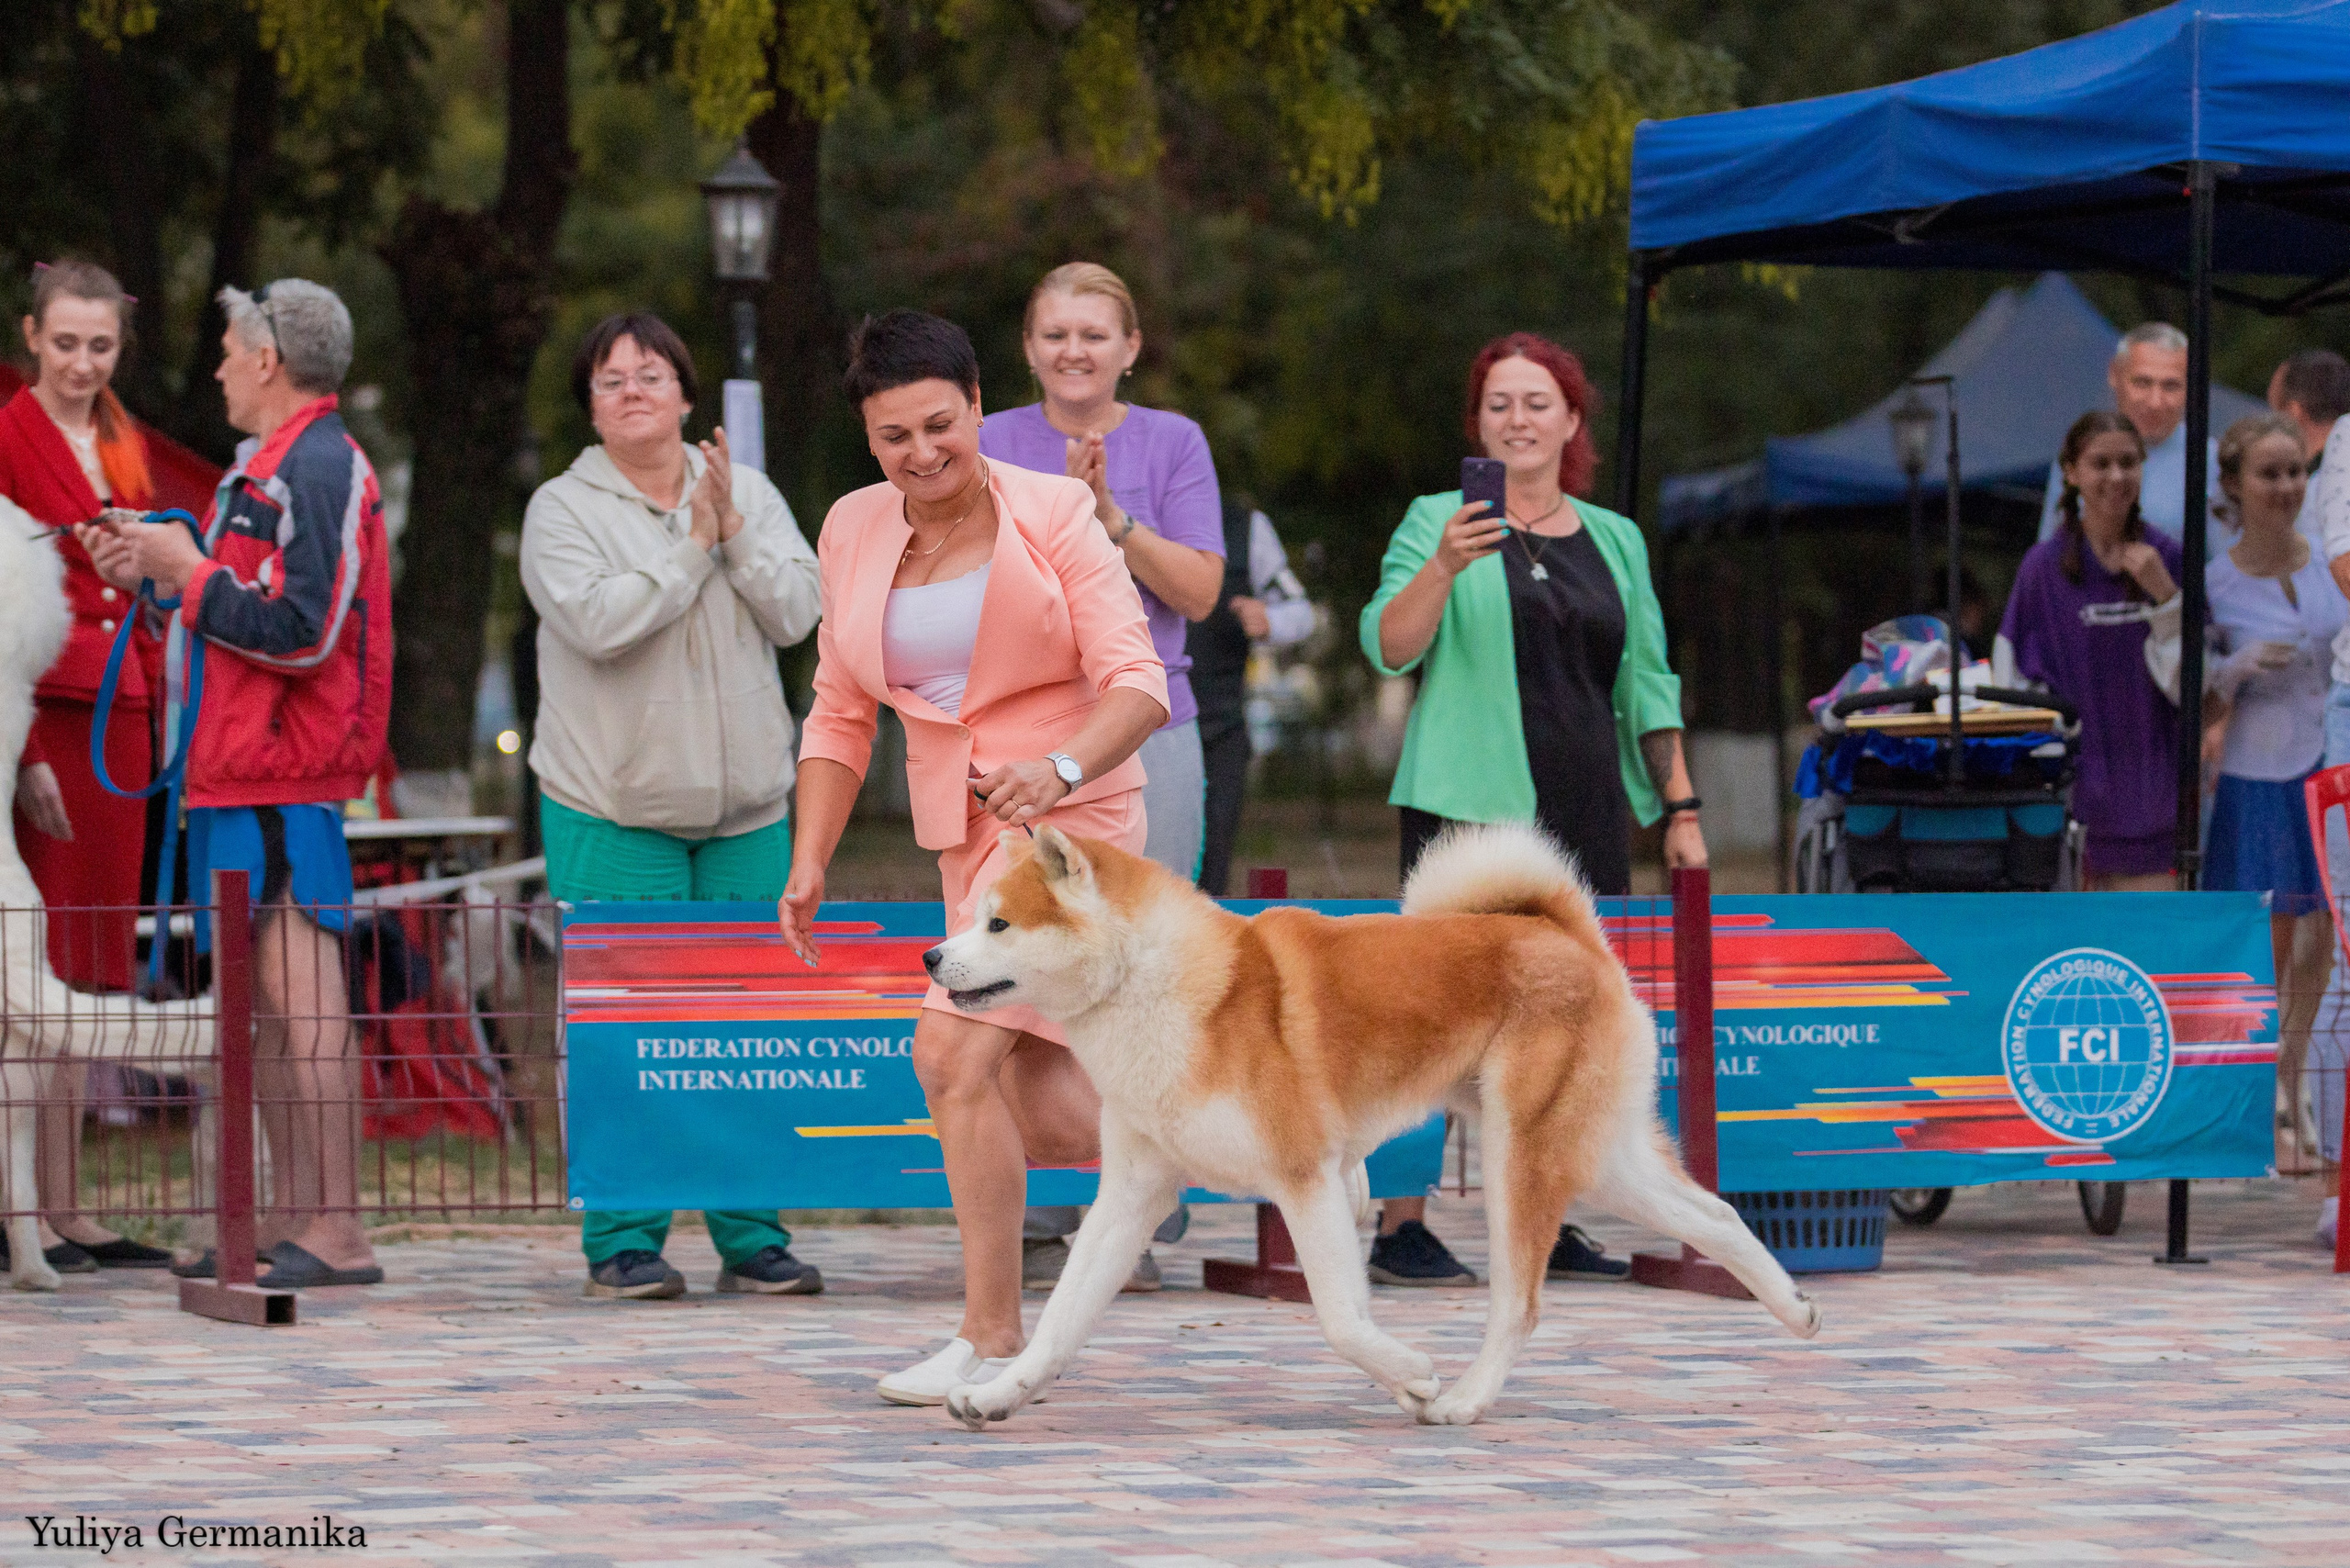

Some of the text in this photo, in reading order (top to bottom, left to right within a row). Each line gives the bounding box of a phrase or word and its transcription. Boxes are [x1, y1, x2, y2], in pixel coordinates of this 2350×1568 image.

[636, 1036, 915, 1058] FEDERATION CYNOLO
[2010, 958, 2165, 1130] FEDERATION CYNOLOGIQUE INTERNATIONALE
[2058, 1026, 2121, 1063] FCI
[638, 1069, 867, 1091] INTERNATIONALE
